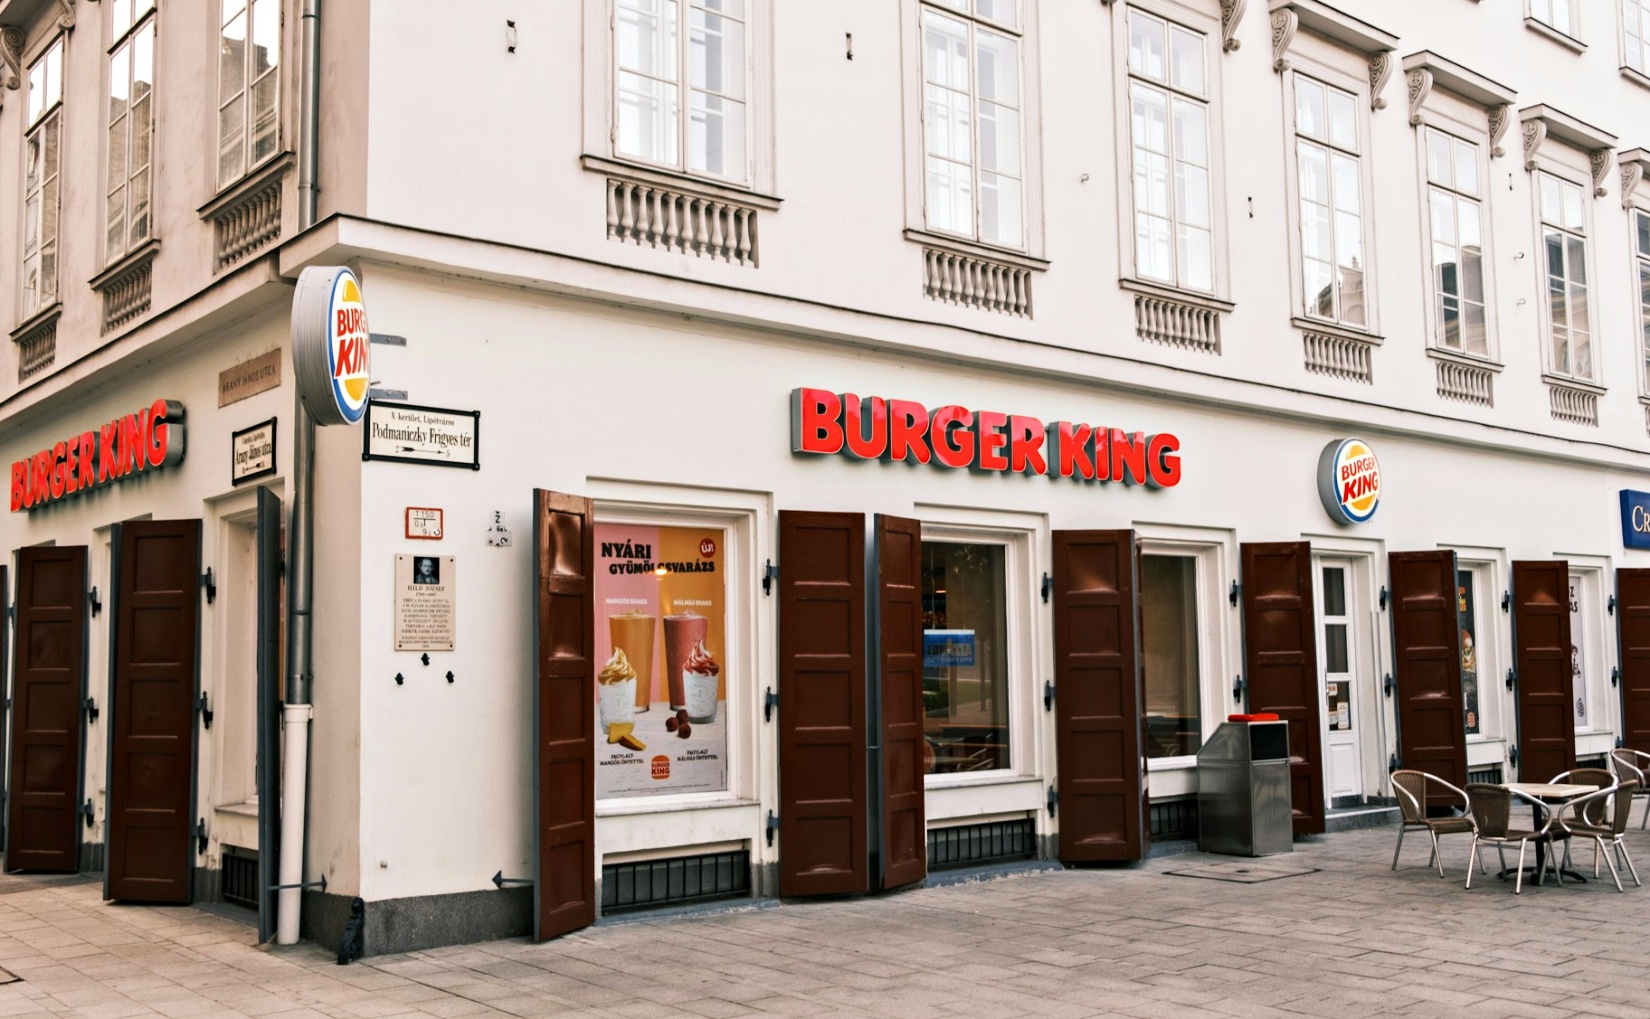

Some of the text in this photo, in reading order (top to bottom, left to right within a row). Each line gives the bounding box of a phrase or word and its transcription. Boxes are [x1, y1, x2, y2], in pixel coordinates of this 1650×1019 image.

[335, 337, 370, 377] KIN
[260, 364, 275, 379] UTCA
[423, 415, 455, 426] Lipótváros
[372, 422, 472, 448] Podmaniczky Frigyes tér
[801, 387, 1181, 488] BURGER KING
[11, 399, 169, 513] BURGER KING
[1341, 456, 1376, 481] BURGER
[1343, 471, 1378, 503] KING
[601, 539, 651, 559] NYÁRI
[701, 543, 714, 553] ÚJ!
